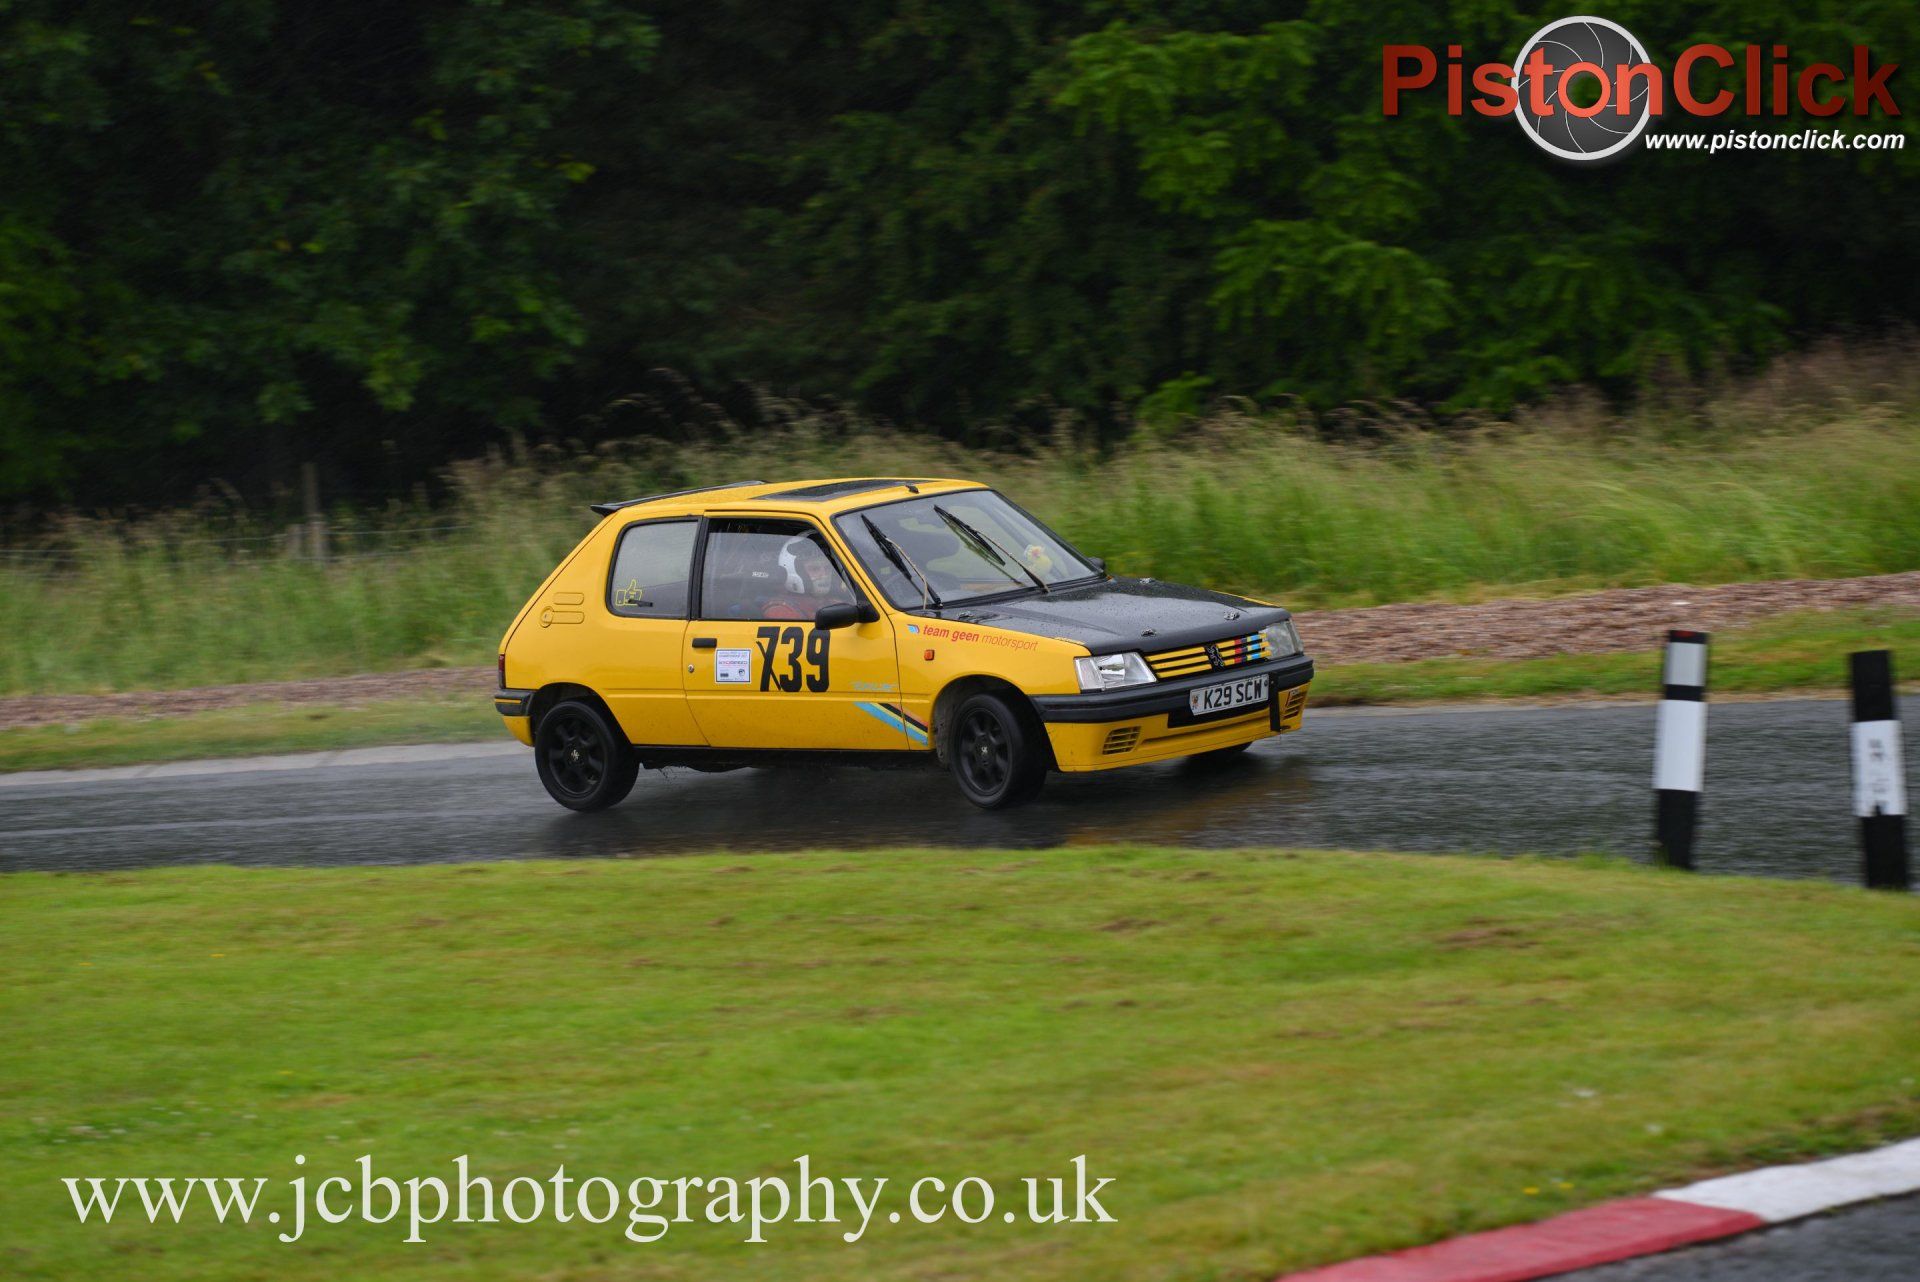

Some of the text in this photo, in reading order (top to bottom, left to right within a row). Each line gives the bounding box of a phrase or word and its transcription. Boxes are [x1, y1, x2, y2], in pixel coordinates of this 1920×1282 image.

[923, 625, 1039, 651] team geen motorsport
[756, 626, 831, 692] 739
[1204, 679, 1262, 709] K29 SCW
